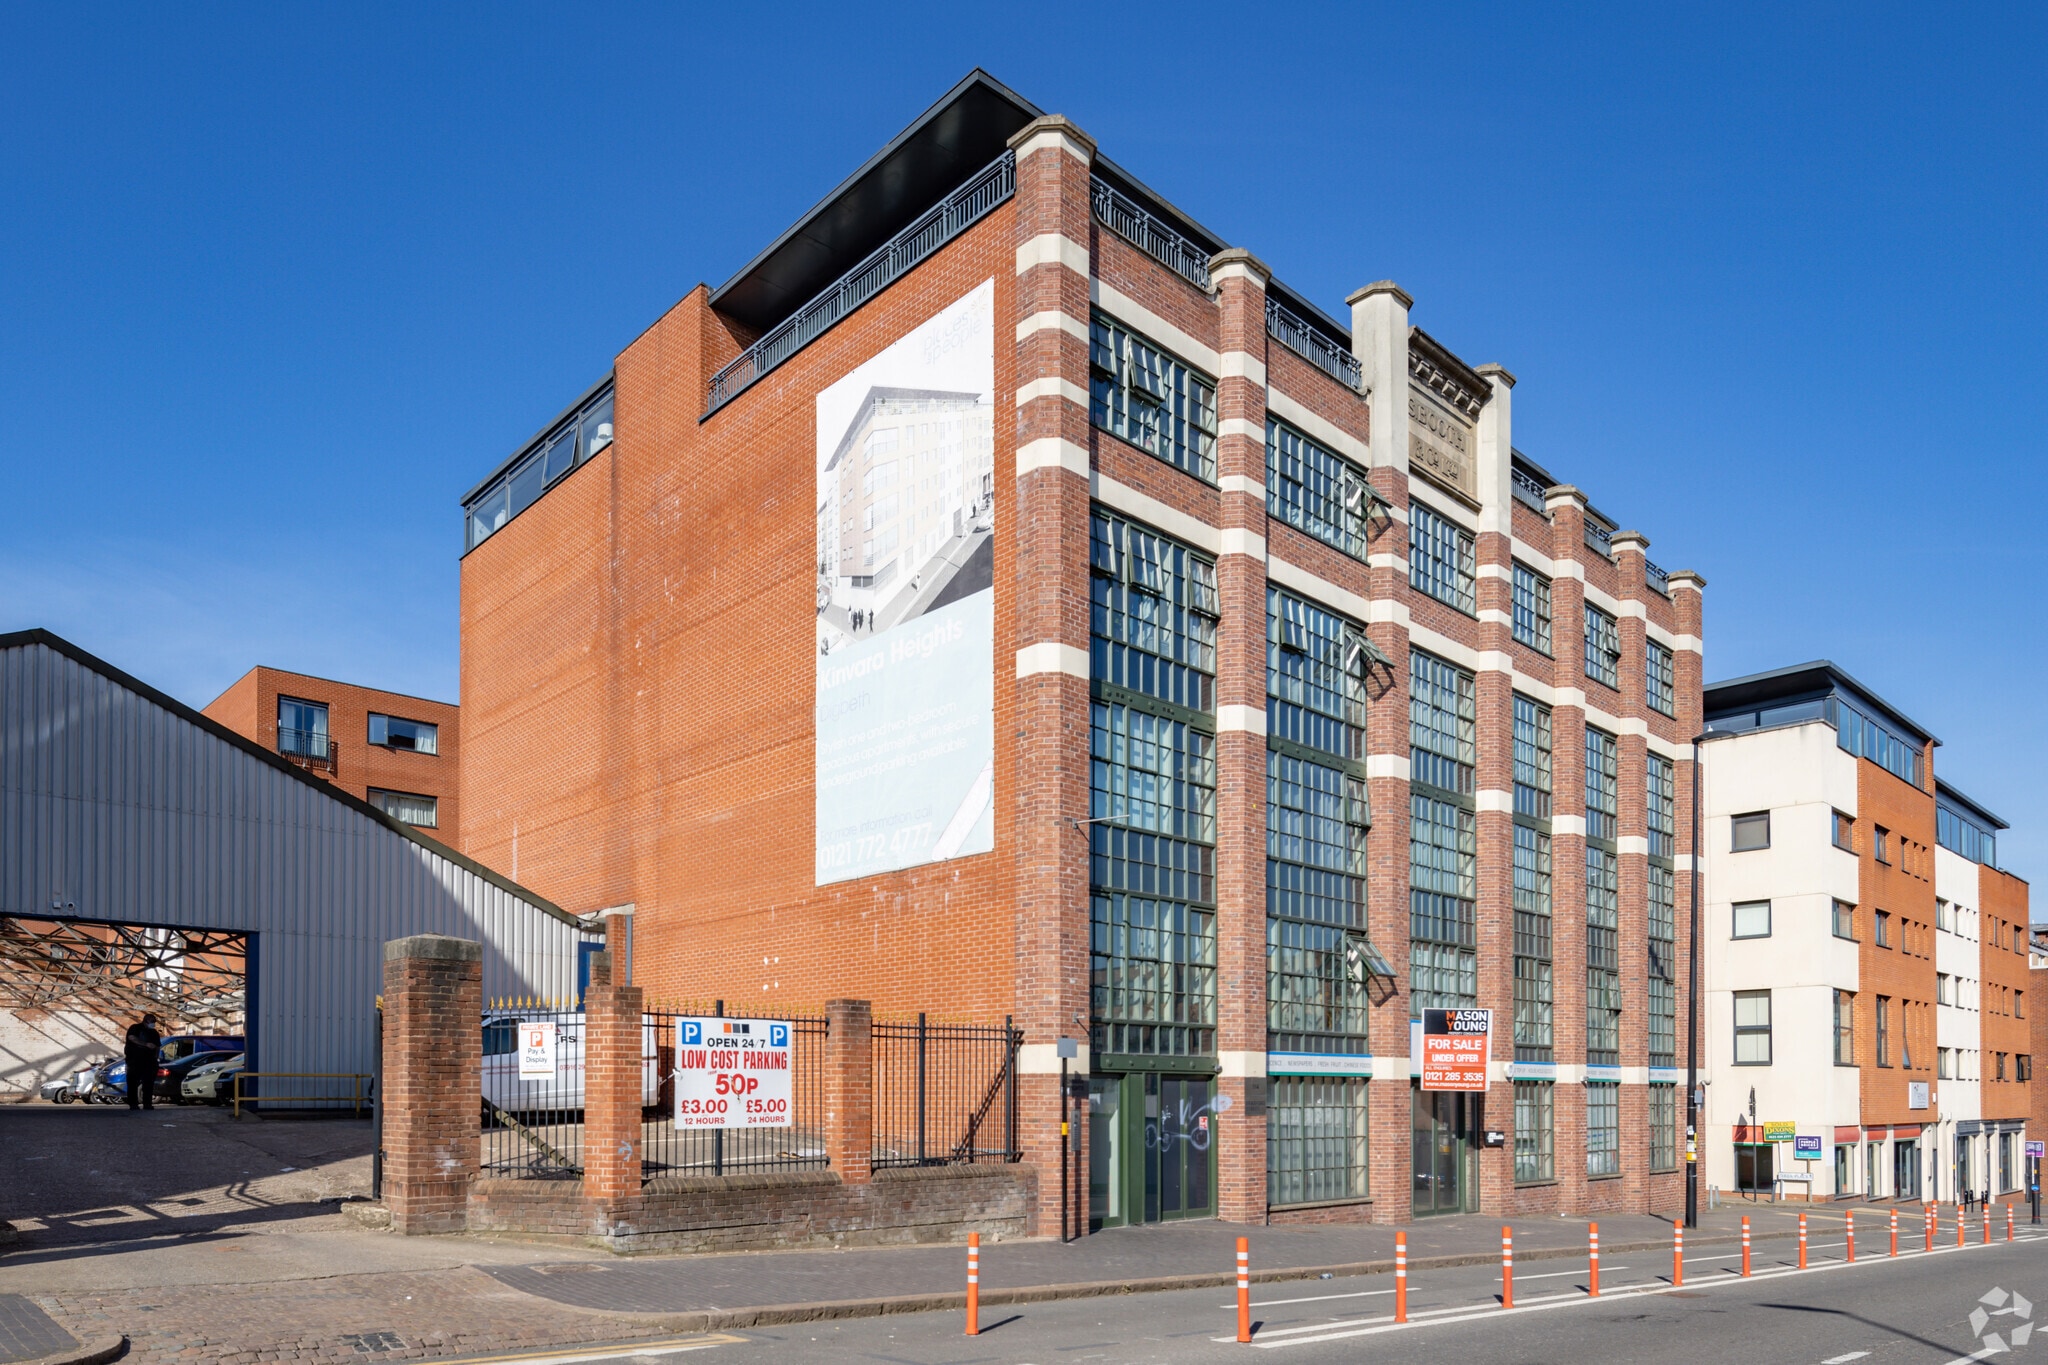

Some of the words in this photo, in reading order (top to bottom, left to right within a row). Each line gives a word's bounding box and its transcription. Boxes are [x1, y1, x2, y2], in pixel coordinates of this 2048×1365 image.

[820, 651, 884, 691] Kinvara
[890, 618, 964, 664] Heights
[820, 690, 871, 723] Digbeth
[848, 734, 865, 746] one
[866, 721, 886, 741] and
[921, 723, 941, 740] with
[942, 713, 980, 731] secure
[873, 752, 918, 776] parking
[834, 824, 858, 838] more
[859, 811, 912, 834] information
[914, 805, 933, 821] call
[820, 841, 852, 870] 0121
[856, 833, 886, 862] 772
[889, 821, 933, 852] 4777
[1446, 1010, 1487, 1021] MASON
[685, 1024, 699, 1043] P
[1446, 1021, 1487, 1031] YOUNG
[707, 1038, 739, 1048] OPEN
[742, 1039, 766, 1049] 24/7
[773, 1027, 785, 1045] P
[1428, 1038, 1451, 1050] FOR
[1453, 1040, 1483, 1050] SALE
[681, 1050, 707, 1069] LOW
[711, 1050, 739, 1069] COST
[743, 1051, 788, 1070] PARKING
[1432, 1054, 1455, 1062] UNDER
[1456, 1054, 1479, 1062] OFFER
[1425, 1072, 1443, 1080] 0121
[1445, 1072, 1461, 1080] 285
[1463, 1072, 1484, 1081] 3535
[681, 1099, 728, 1114] £3.00
[746, 1099, 787, 1113] £5.00
